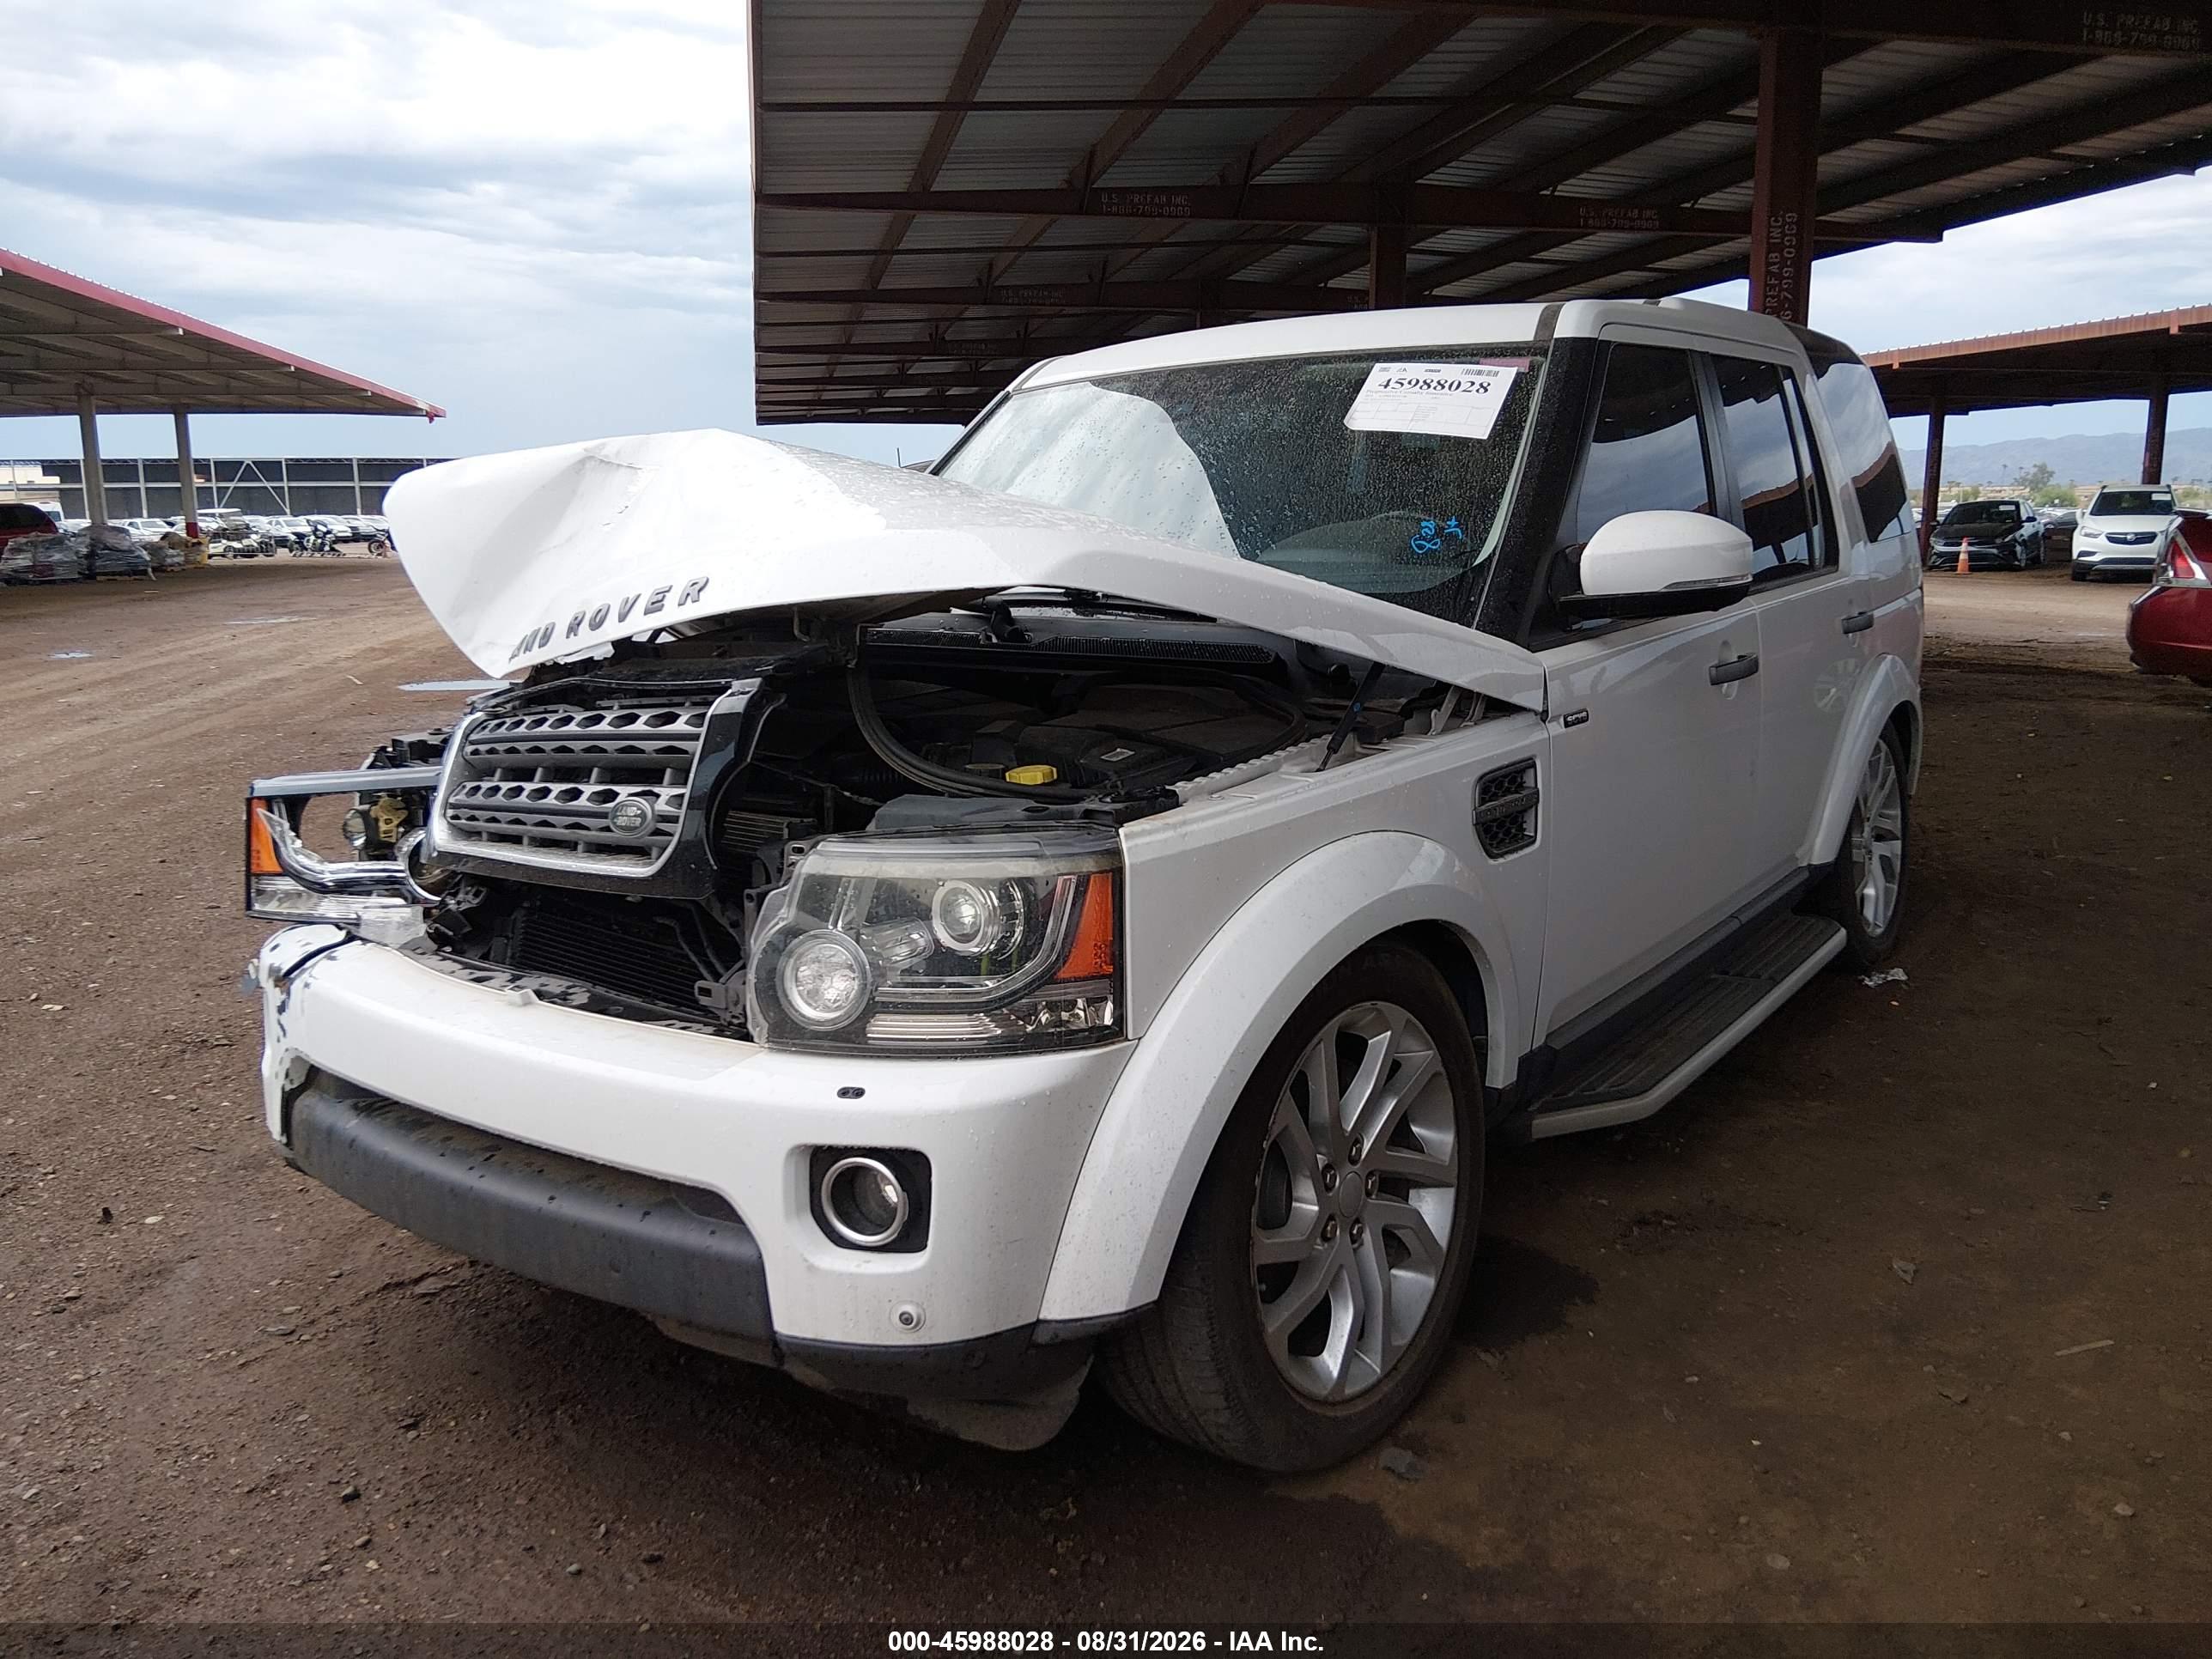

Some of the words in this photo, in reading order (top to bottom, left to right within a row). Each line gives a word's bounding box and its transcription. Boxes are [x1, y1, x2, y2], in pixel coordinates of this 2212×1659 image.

[1769, 210, 1784, 243] INC.
[1377, 377, 1492, 395] 45988028
[566, 576, 709, 639] ROVER
